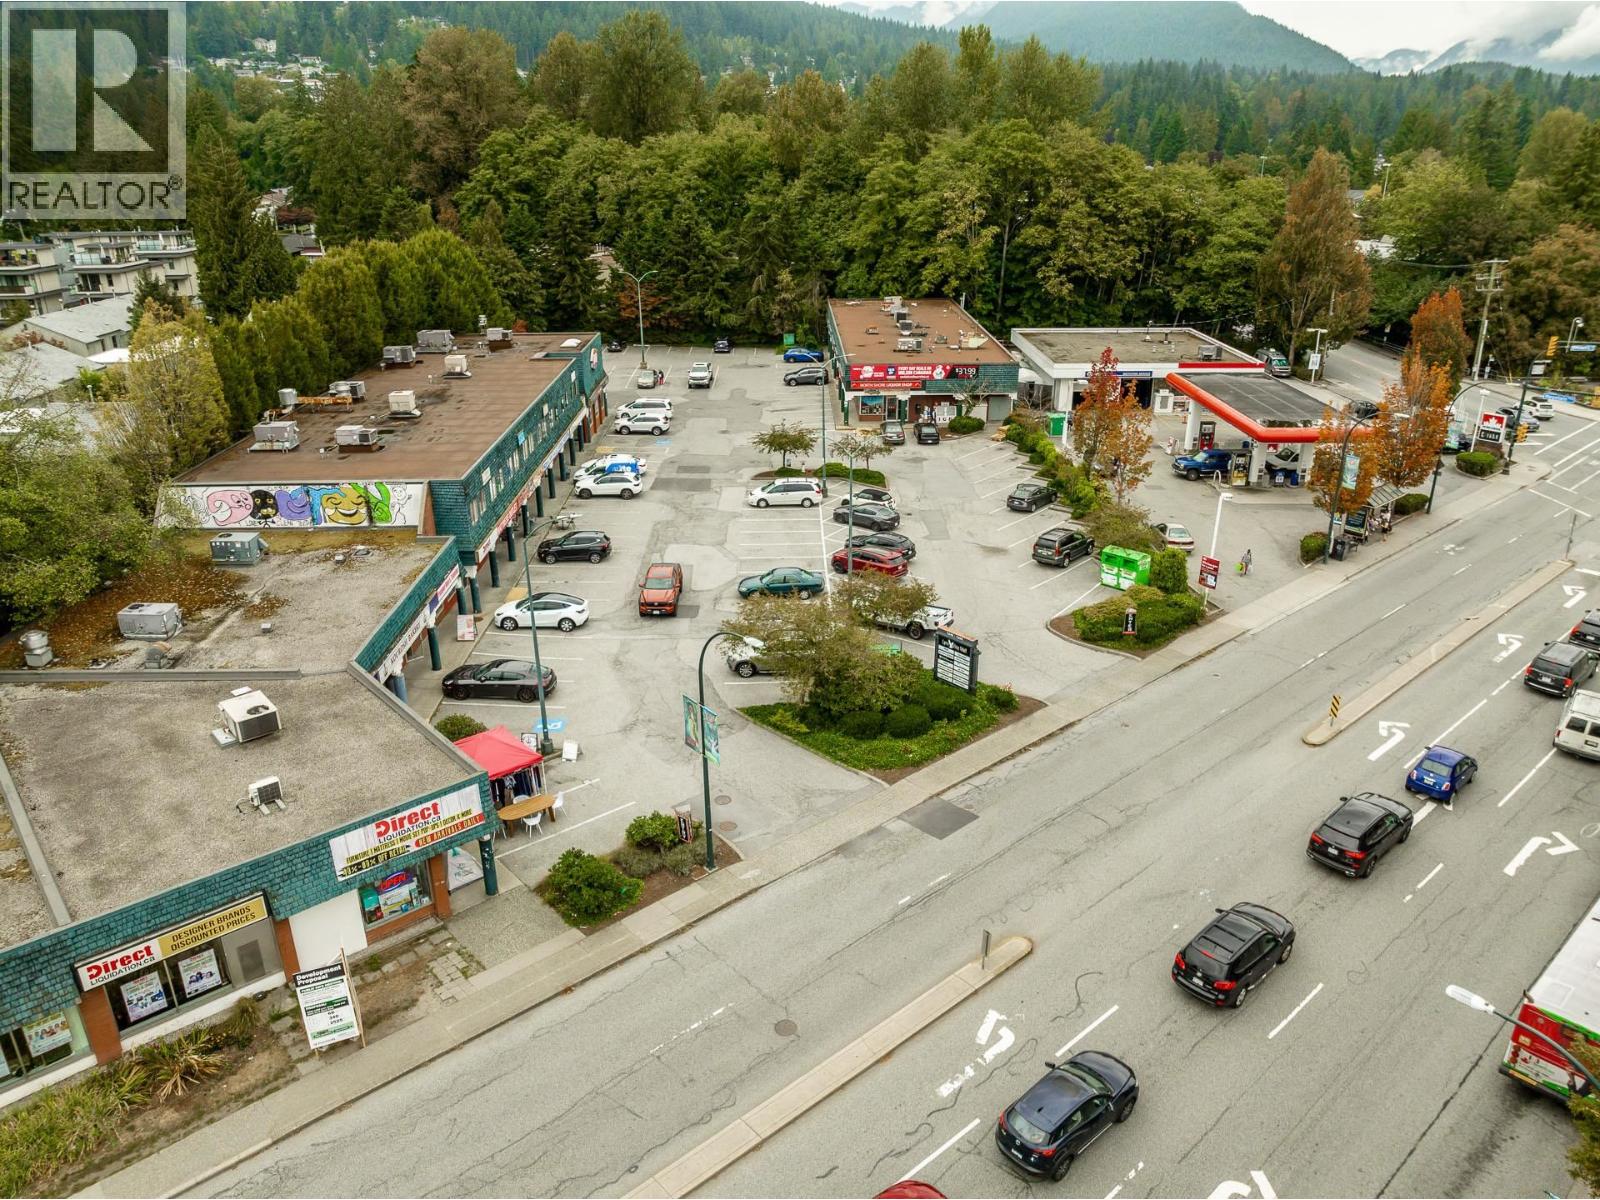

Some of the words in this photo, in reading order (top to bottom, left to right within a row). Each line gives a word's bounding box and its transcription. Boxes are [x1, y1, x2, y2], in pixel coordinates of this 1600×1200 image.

[375, 801, 440, 838] Direct
[378, 815, 441, 844] LIQUIDATION.ca
[418, 834, 431, 847] NEW
[433, 821, 461, 840] ARRIVALS
[463, 814, 481, 828] DAILY
[171, 923, 225, 952] DISCOUNTED
[226, 911, 256, 930] PRICES
[172, 919, 215, 943] DESIGNER
[216, 905, 251, 925] BRANDS
[86, 944, 154, 980] Direct
[90, 955, 156, 987] LIQUIDATION.ca
[296, 964, 342, 981] Development
[297, 973, 329, 987] Proposal
